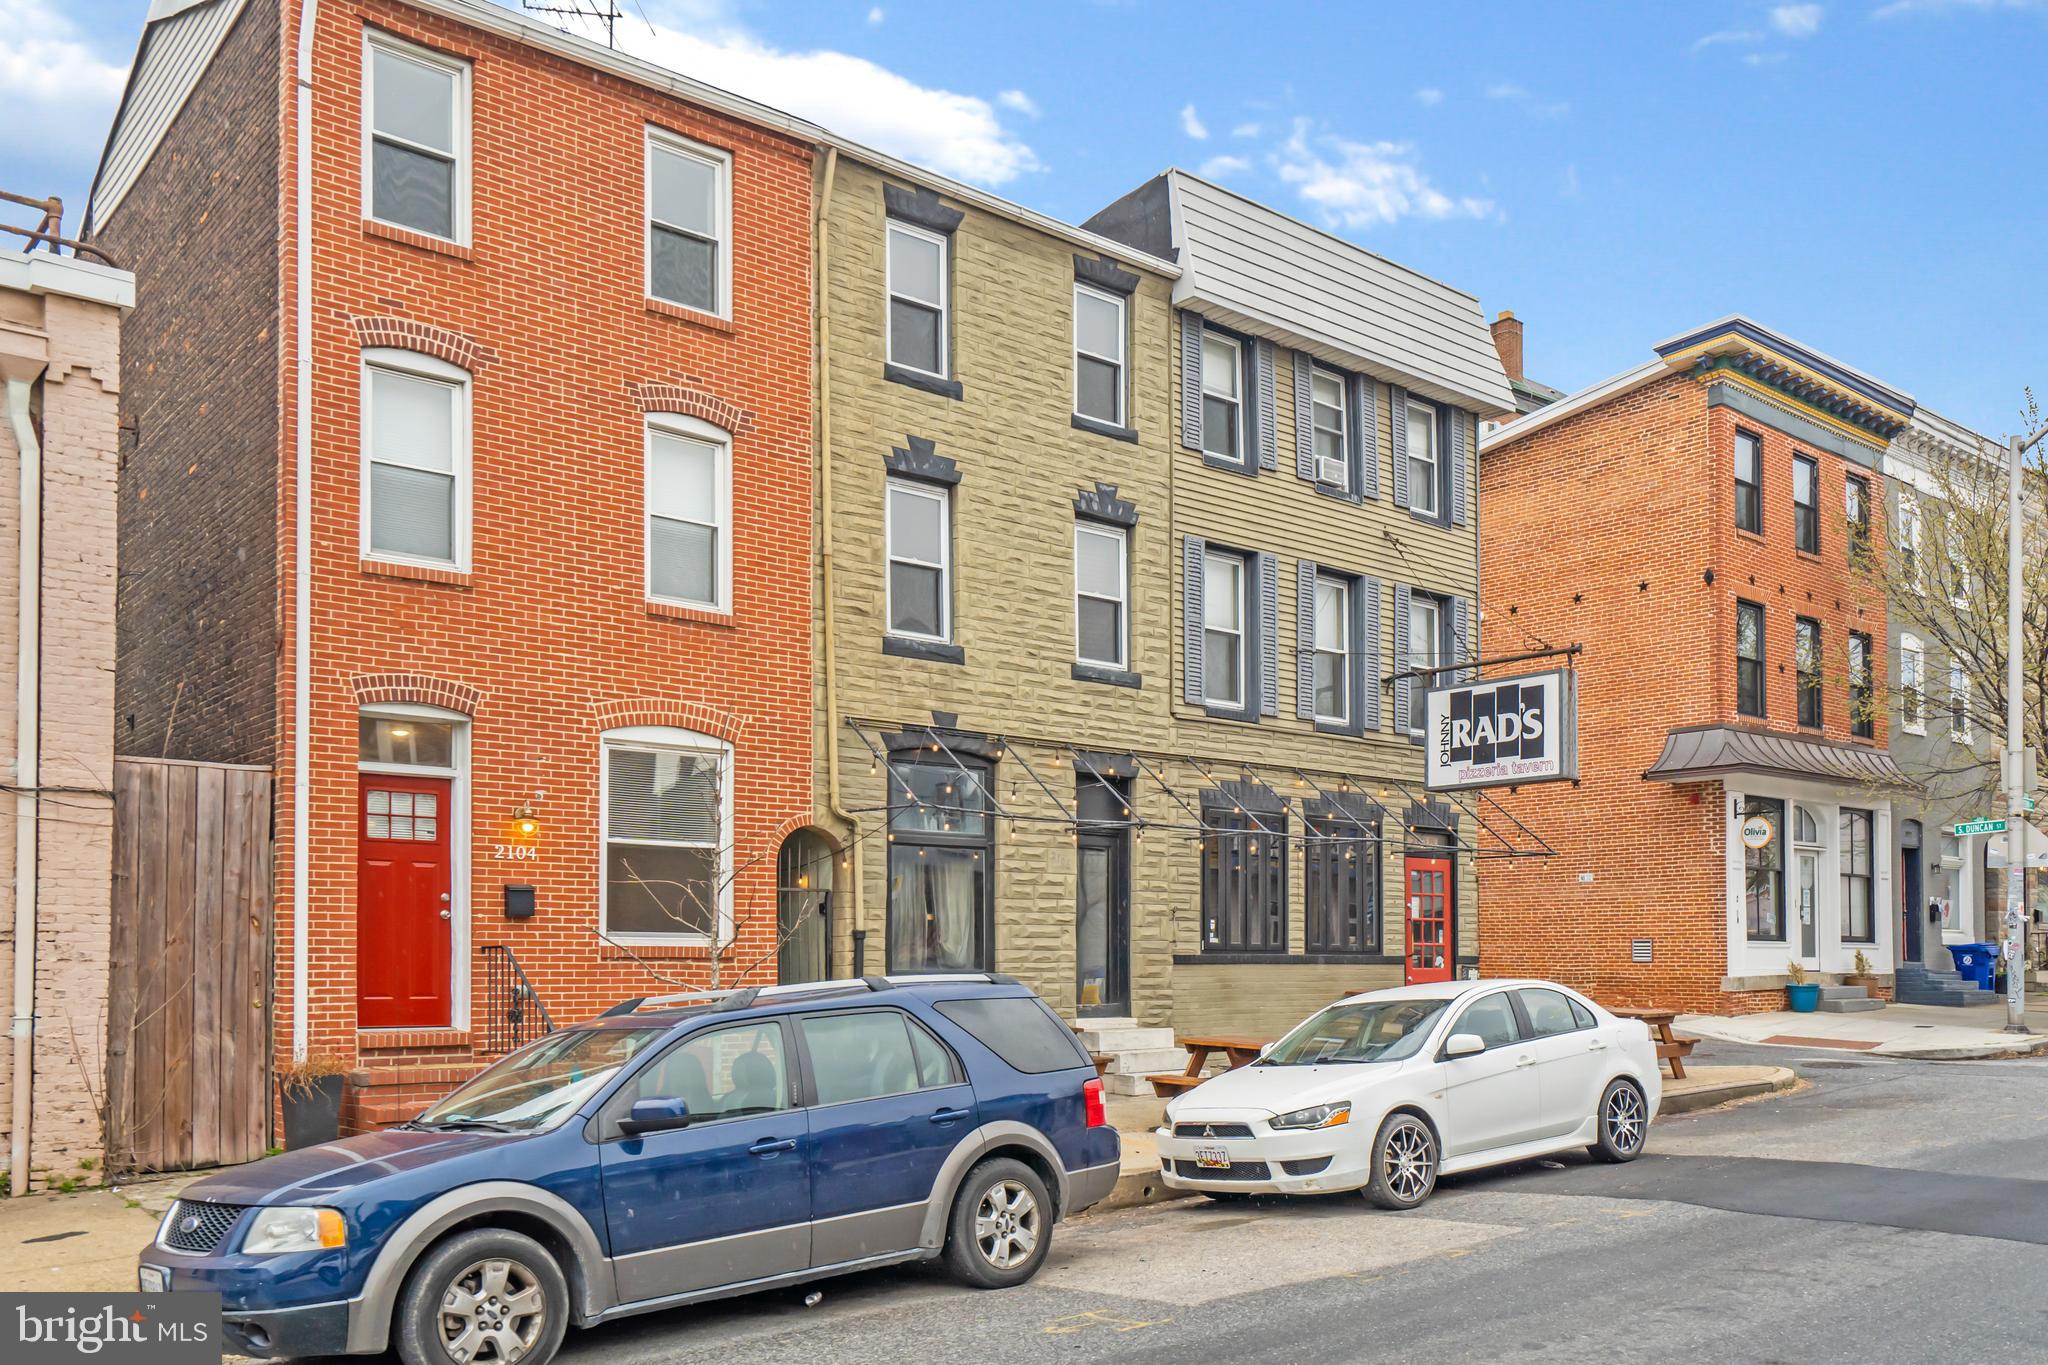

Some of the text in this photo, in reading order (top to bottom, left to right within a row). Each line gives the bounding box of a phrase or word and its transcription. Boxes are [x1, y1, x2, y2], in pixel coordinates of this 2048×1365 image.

[1451, 702, 1543, 749] RAD'S
[1440, 713, 1452, 768] JOHNNY
[1458, 760, 1554, 783] pizzeria tavern
[1744, 827, 1767, 836] Olivia
[1965, 822, 1994, 833] DUNCAN
[494, 844, 537, 860] 2104
